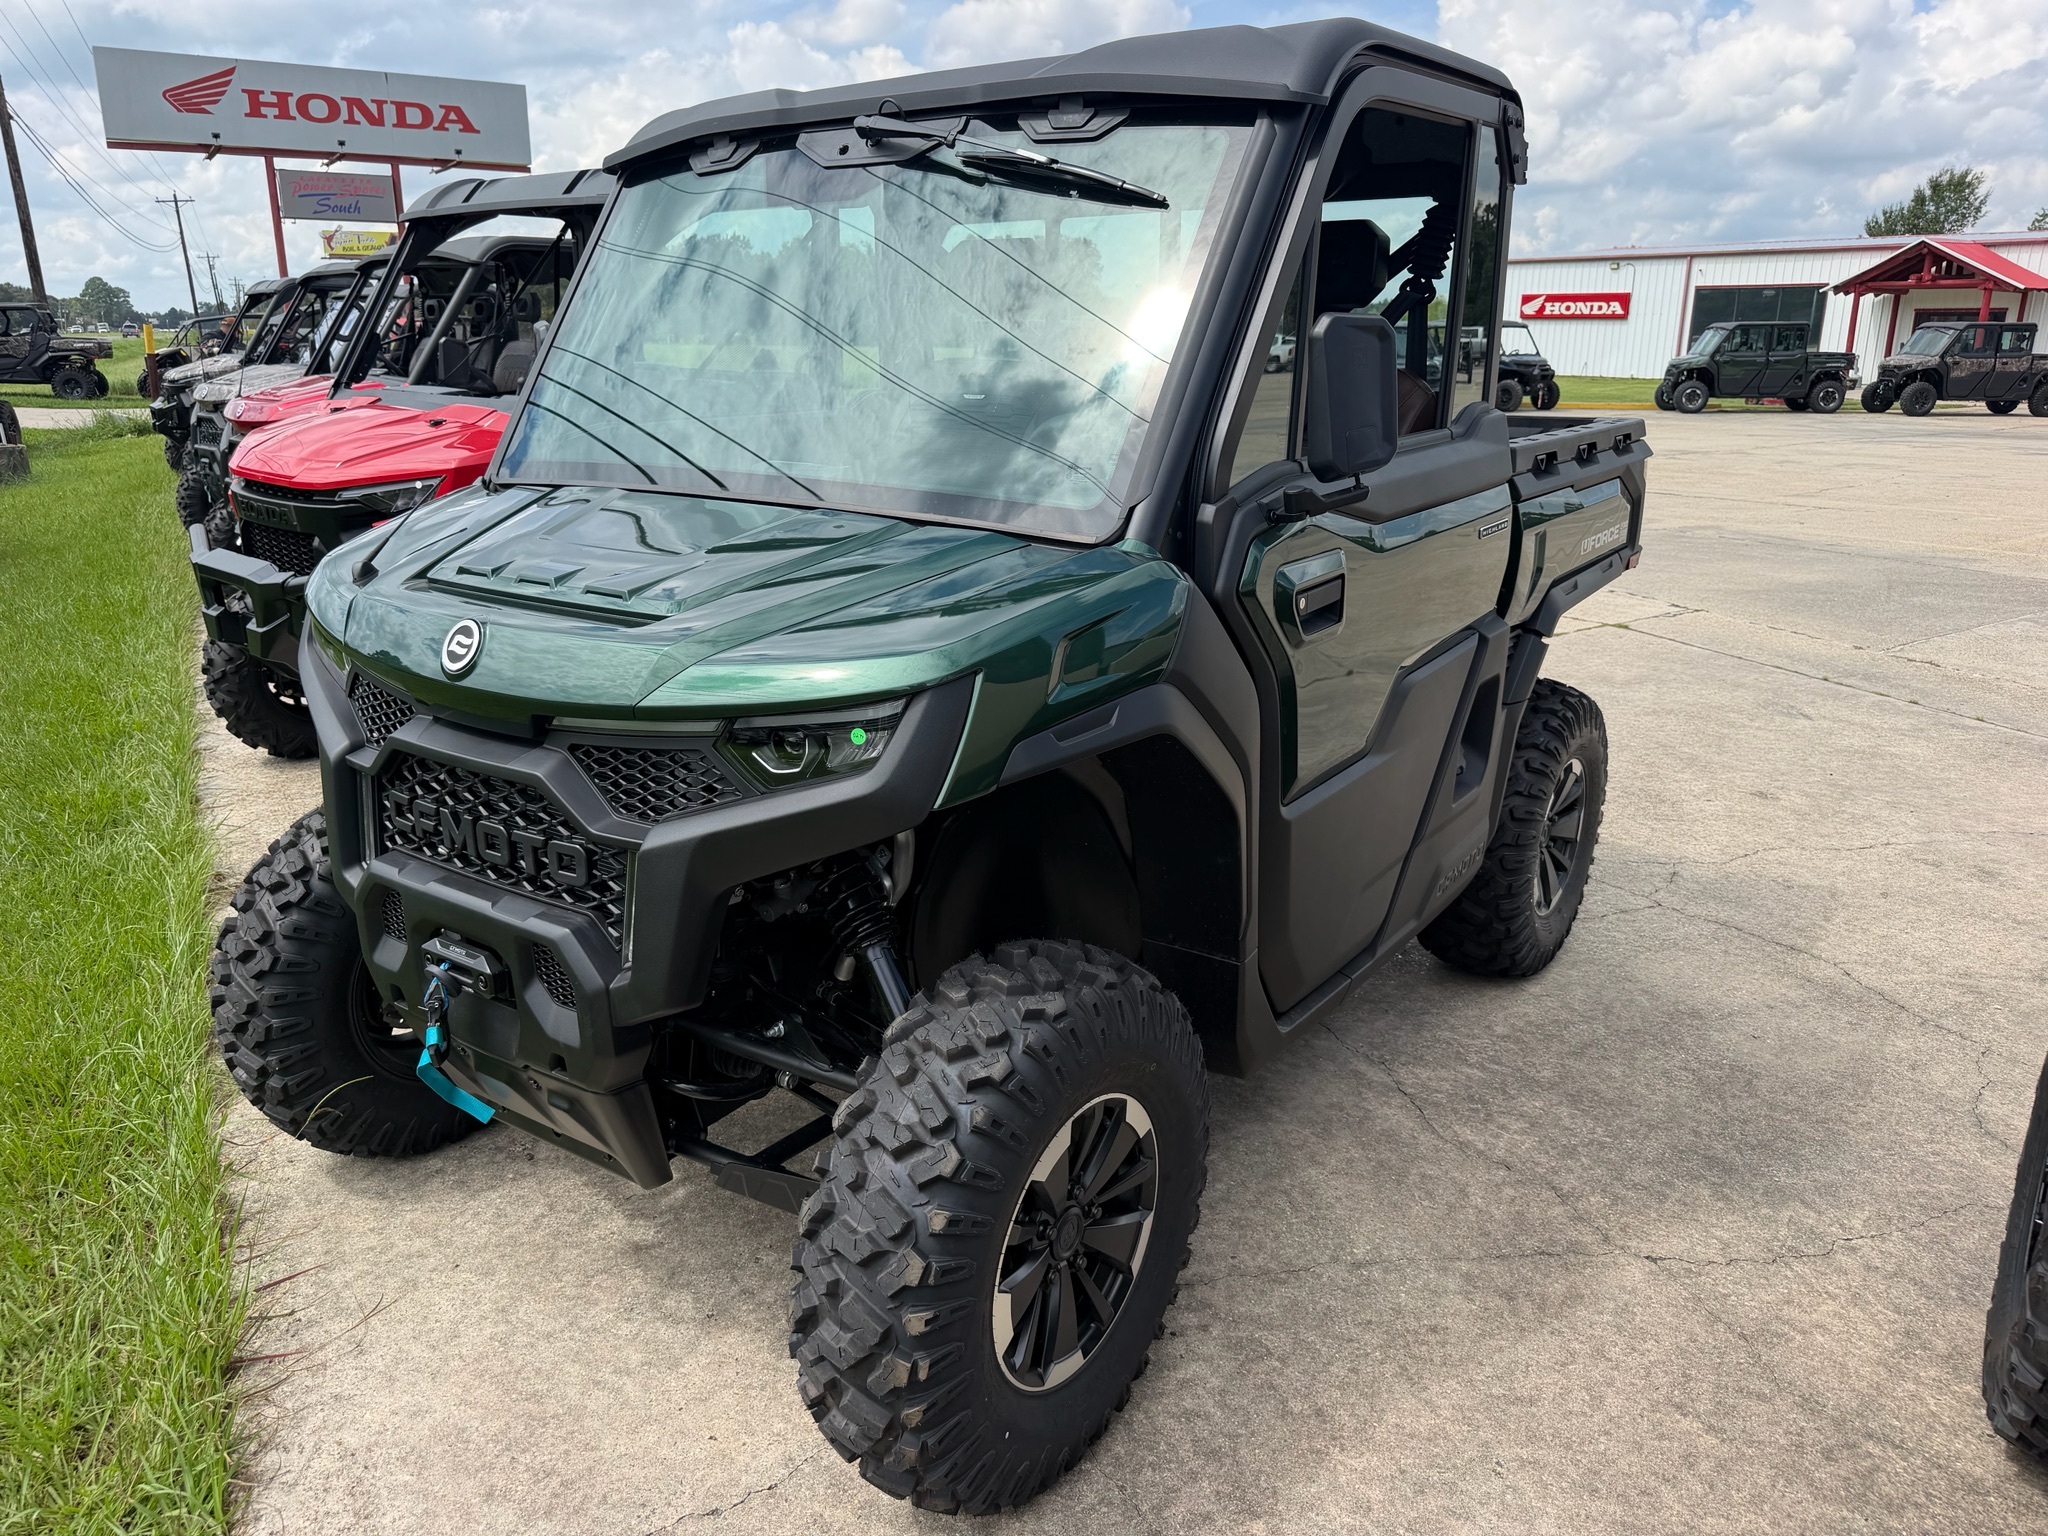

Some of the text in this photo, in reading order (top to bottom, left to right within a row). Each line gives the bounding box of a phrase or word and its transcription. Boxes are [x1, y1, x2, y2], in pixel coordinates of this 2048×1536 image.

[241, 88, 481, 135] HONDA
[288, 180, 334, 198] Power
[312, 197, 361, 215] South
[1543, 301, 1625, 315] HONDA
[239, 498, 293, 525] HONDA
[388, 789, 590, 888] CFMOTO
